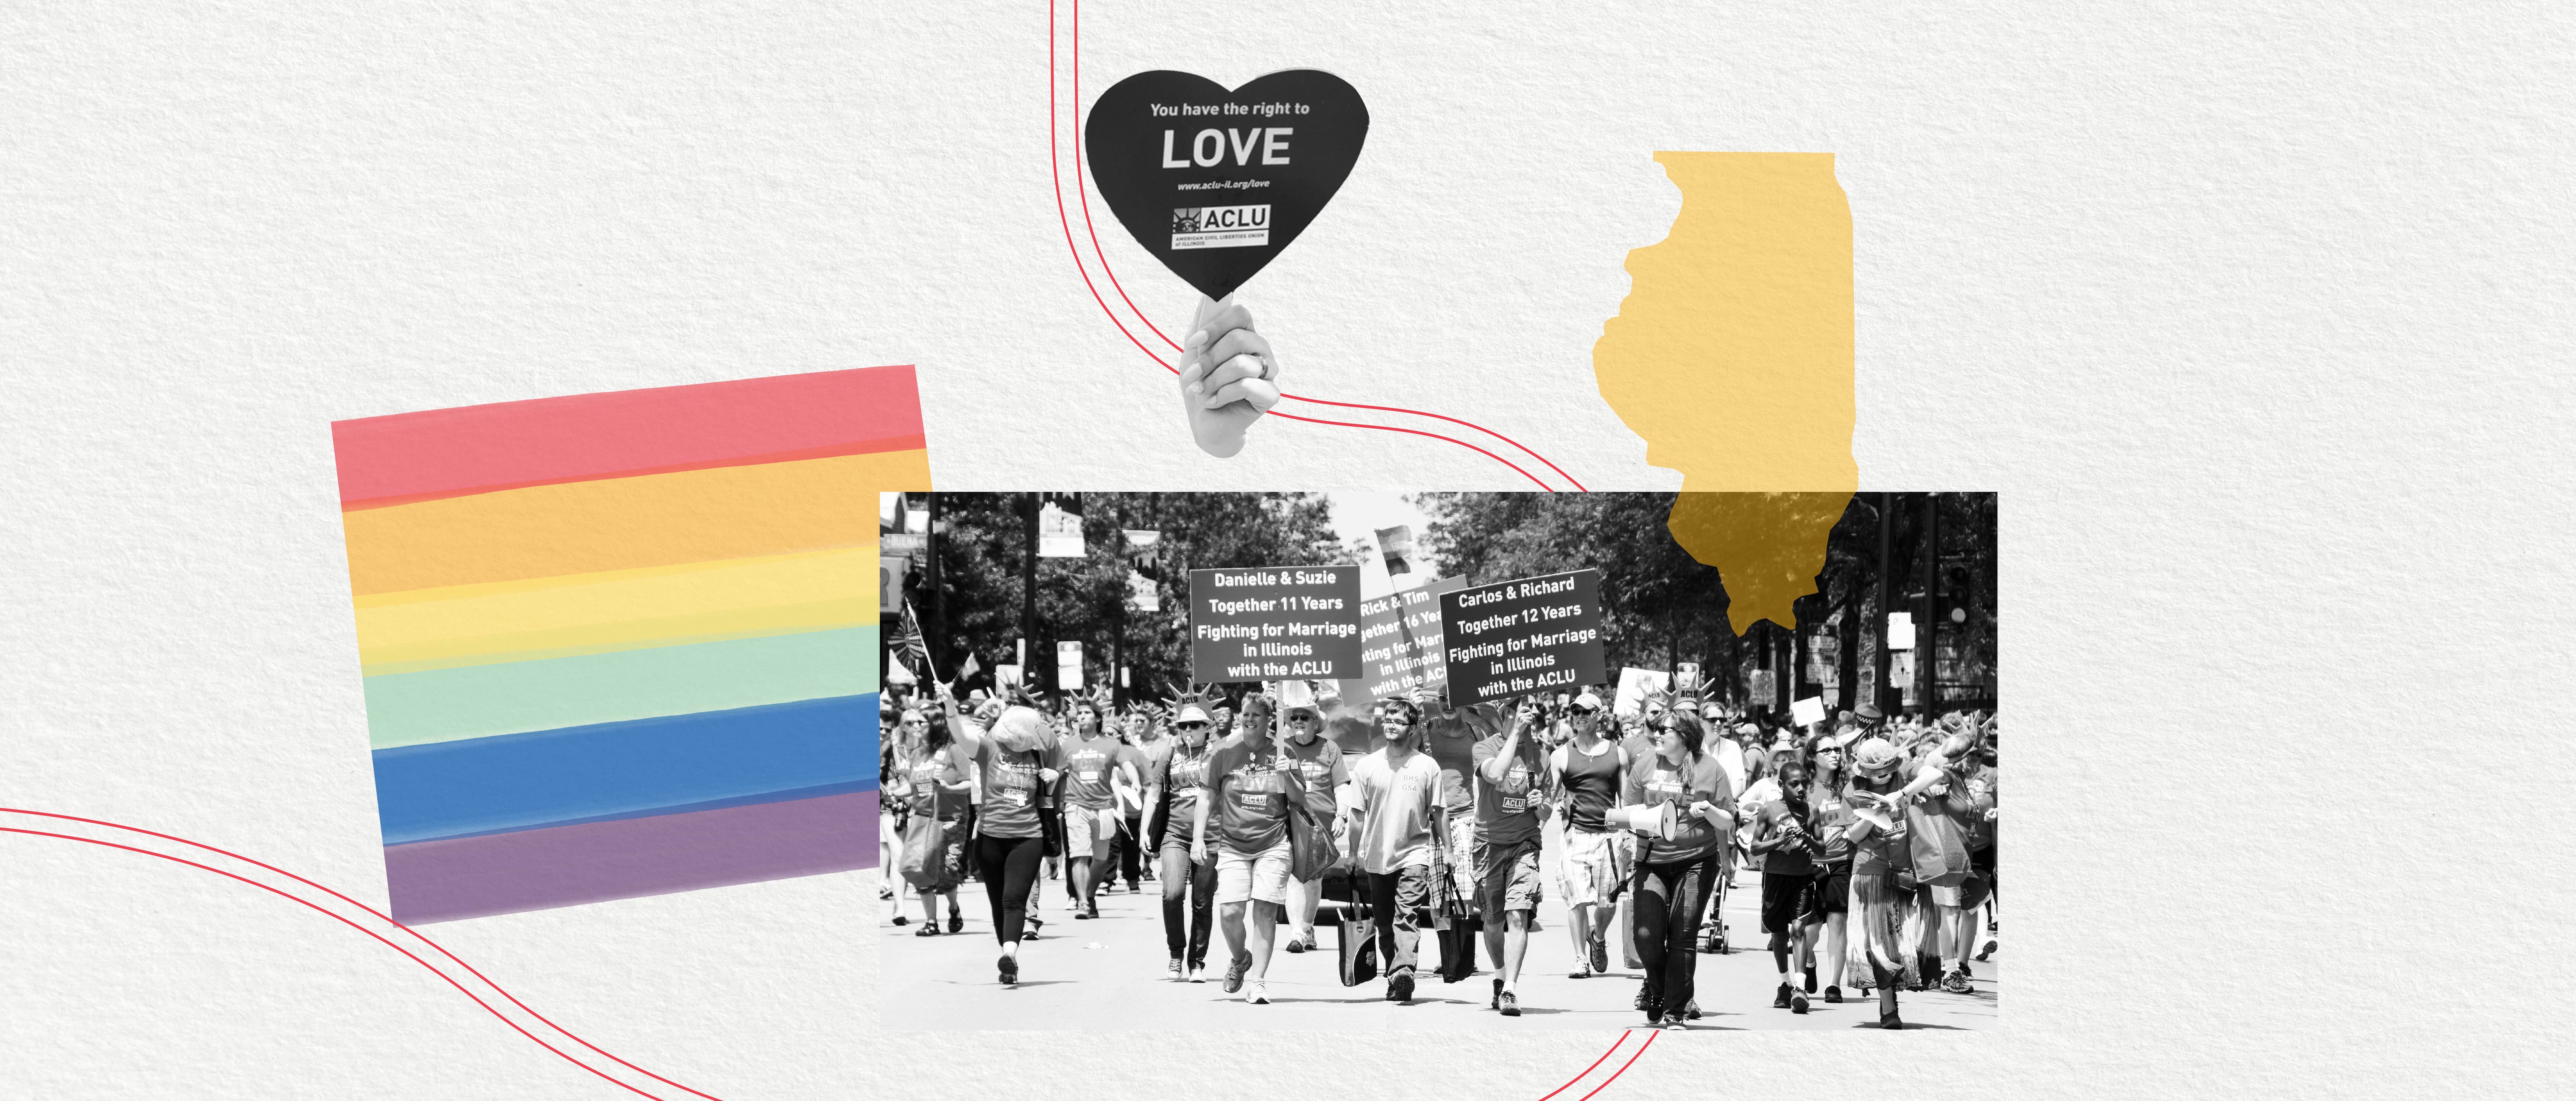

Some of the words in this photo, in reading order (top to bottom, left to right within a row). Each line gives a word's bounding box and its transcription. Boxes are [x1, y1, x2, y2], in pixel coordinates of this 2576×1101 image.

[1150, 103, 1178, 116] You
[1182, 103, 1220, 116] have
[1224, 102, 1249, 115] the
[1253, 102, 1291, 117] right
[1295, 102, 1310, 115] to
[1162, 127, 1294, 169] LOVE
[1177, 179, 1270, 190] www.aclu-il.org/love
[1204, 208, 1266, 228] ACLU
[1215, 572, 1277, 587] Danielle
[1280, 571, 1292, 585] &
[1295, 570, 1337, 585] Suzie
[1459, 590, 1503, 608] Carlos
[1506, 586, 1517, 600] &
[1520, 576, 1575, 598] Richard
[1209, 598, 1277, 615] Together
[1281, 597, 1296, 611] 11
[1301, 596, 1344, 610] Years
[1360, 600, 1389, 616] Rick
[1391, 596, 1402, 609] &
[1403, 591, 1430, 606] Tim
[1361, 621, 1400, 643] gether
[1403, 614, 1419, 629] 16
[1420, 610, 1442, 624] Yea
[1457, 613, 1518, 635] Together
[1522, 609, 1538, 623] 12
[1541, 604, 1582, 620] Years
[1197, 624, 1259, 642] Fighting
[1262, 623, 1285, 637] for
[1289, 621, 1357, 638] Marriage
[1243, 643, 1257, 657] in
[1261, 642, 1313, 656] Illinois
[1393, 642, 1412, 655] for
[1449, 642, 1504, 663] Fighting
[1507, 638, 1528, 652] for
[1531, 629, 1596, 648] Marriage
[1227, 663, 1260, 677] with
[1264, 662, 1288, 676] the
[1291, 660, 1332, 675] ACLU
[1380, 664, 1393, 676] in
[1395, 652, 1440, 672] Illinois
[1491, 662, 1504, 675] in
[1507, 652, 1555, 672] Illinois
[1370, 678, 1400, 696] with
[1401, 675, 1423, 689] the
[1478, 680, 1508, 697] with
[1511, 677, 1533, 692] the
[1537, 668, 1576, 687] ACLU
[1181, 696, 1198, 705] ACLU
[1680, 690, 1698, 698] ACLU
[1232, 775, 1278, 792] LOVE
[1244, 796, 1264, 804] ACLU
[1504, 799, 1524, 808] ACLU
[1644, 790, 1695, 807] LOVE
